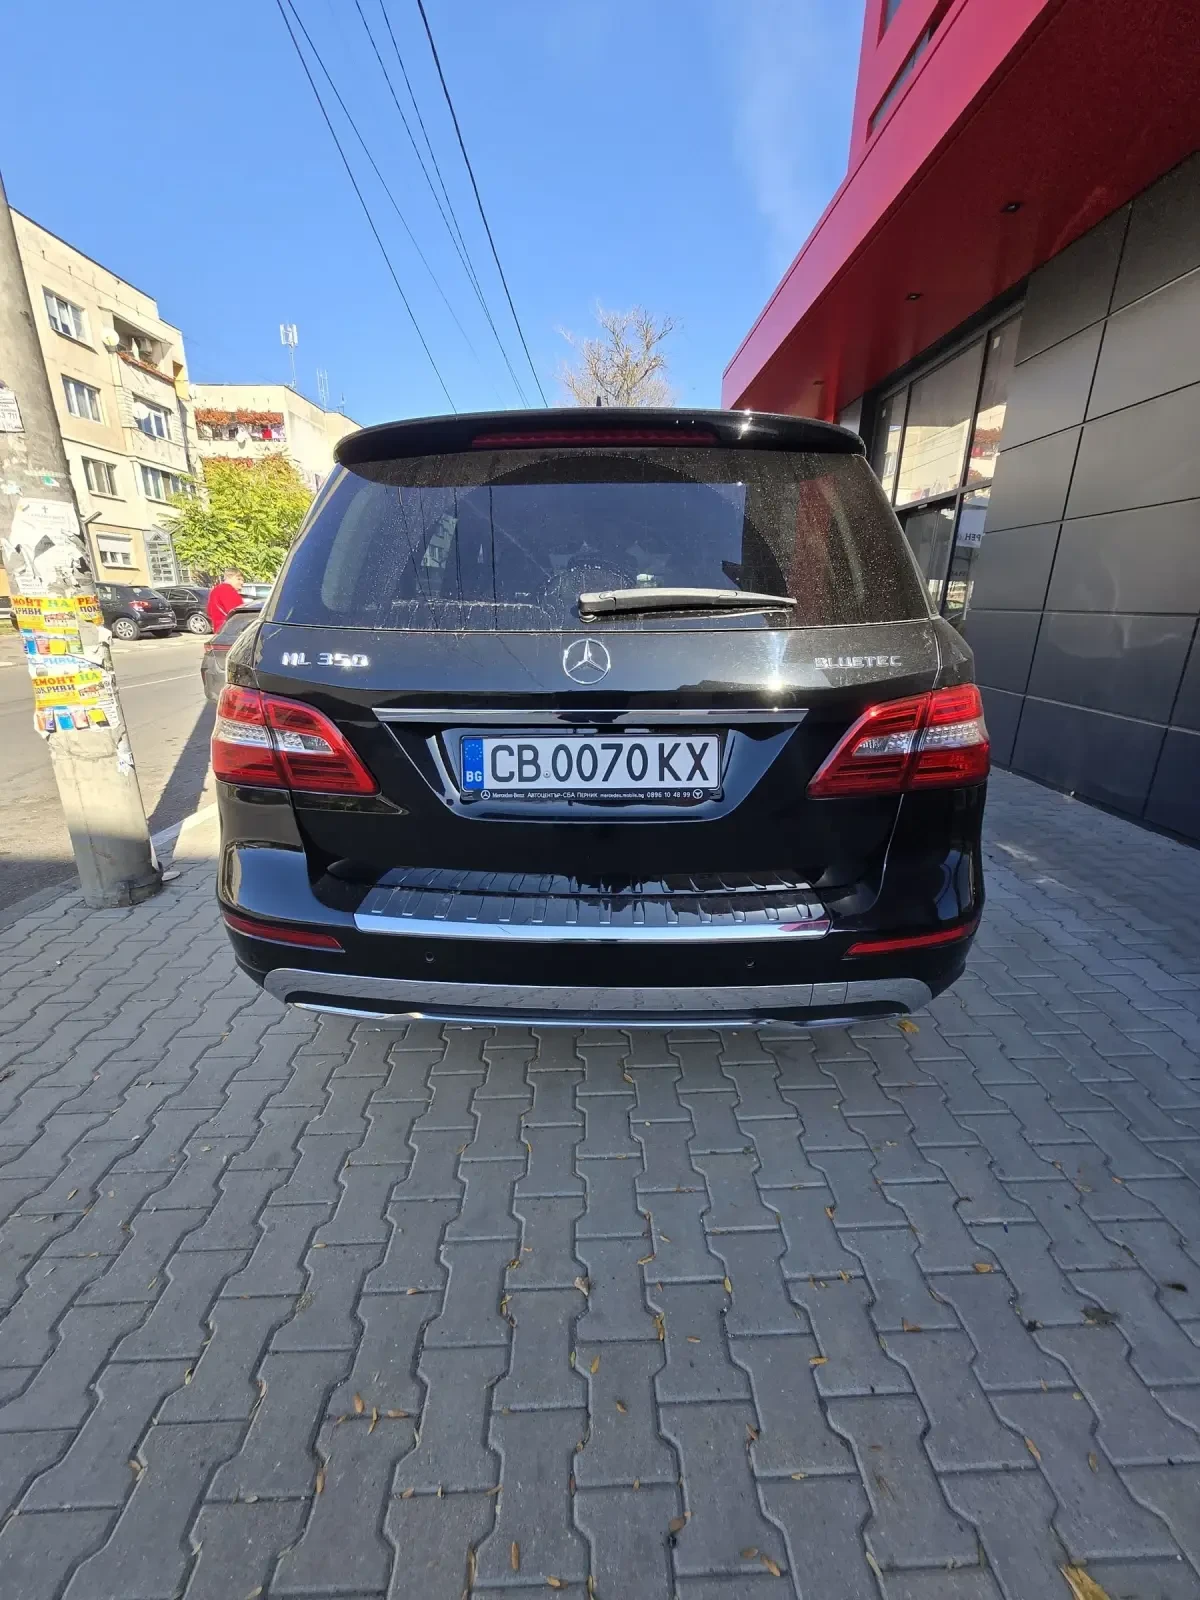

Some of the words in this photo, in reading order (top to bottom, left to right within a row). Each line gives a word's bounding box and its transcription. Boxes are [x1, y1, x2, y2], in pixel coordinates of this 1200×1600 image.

[281, 652, 312, 666] ML
[317, 652, 369, 667] 350
[814, 655, 902, 669] BLUETEC
[551, 743, 648, 782] 0070
[466, 771, 483, 783] BG
